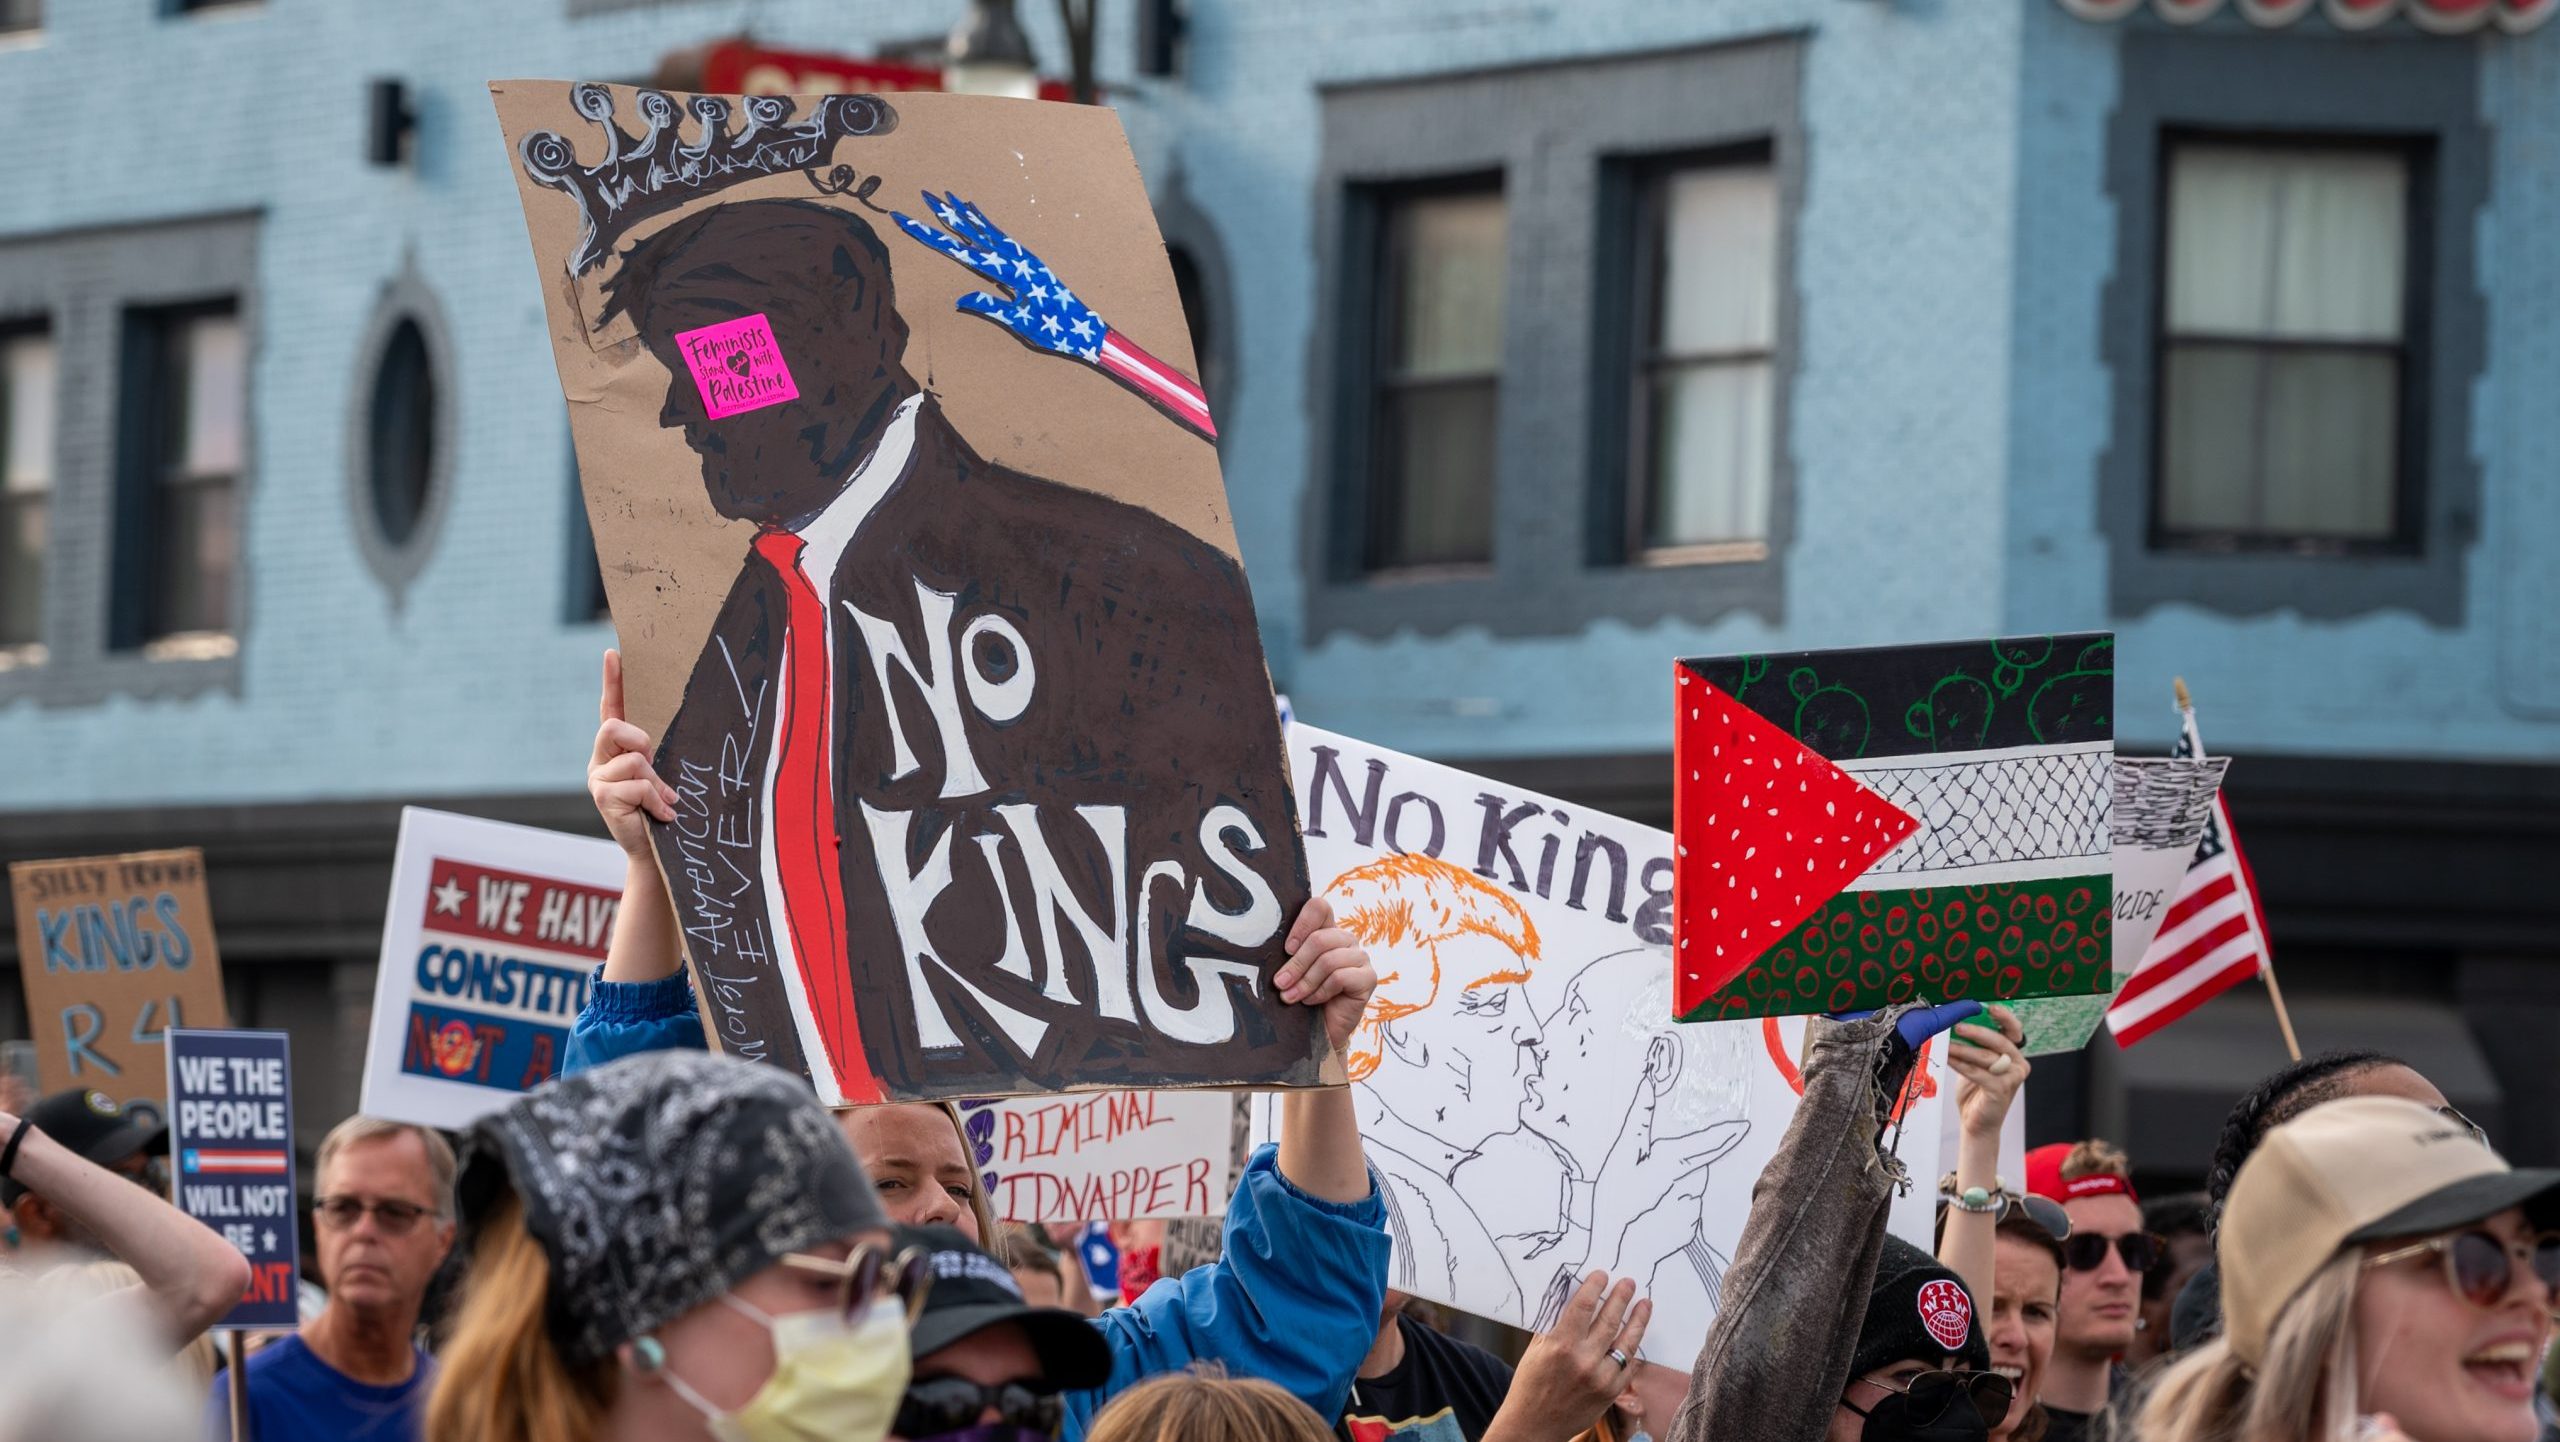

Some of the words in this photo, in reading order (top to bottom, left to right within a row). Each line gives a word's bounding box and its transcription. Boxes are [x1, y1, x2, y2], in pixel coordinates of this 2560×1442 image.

[687, 328, 767, 367] Feminists
[700, 357, 729, 380] stand
[753, 349, 775, 367] with
[709, 372, 786, 410] Palestine
[842, 574, 1036, 798] NO
[1303, 745, 1446, 859] No
[476, 874, 532, 936] WE
[859, 797, 1282, 1060] KINGS
[36, 891, 195, 973] KINGS
[62, 1003, 121, 1077] R
[703, 961, 768, 1067] Worst
[178, 1055, 227, 1095] WE
[228, 1057, 285, 1097] THE
[179, 1099, 287, 1140] PEOPLE
[184, 1184, 241, 1217] WILL
[241, 1185, 289, 1218] NOT
[242, 1261, 293, 1304] NT
